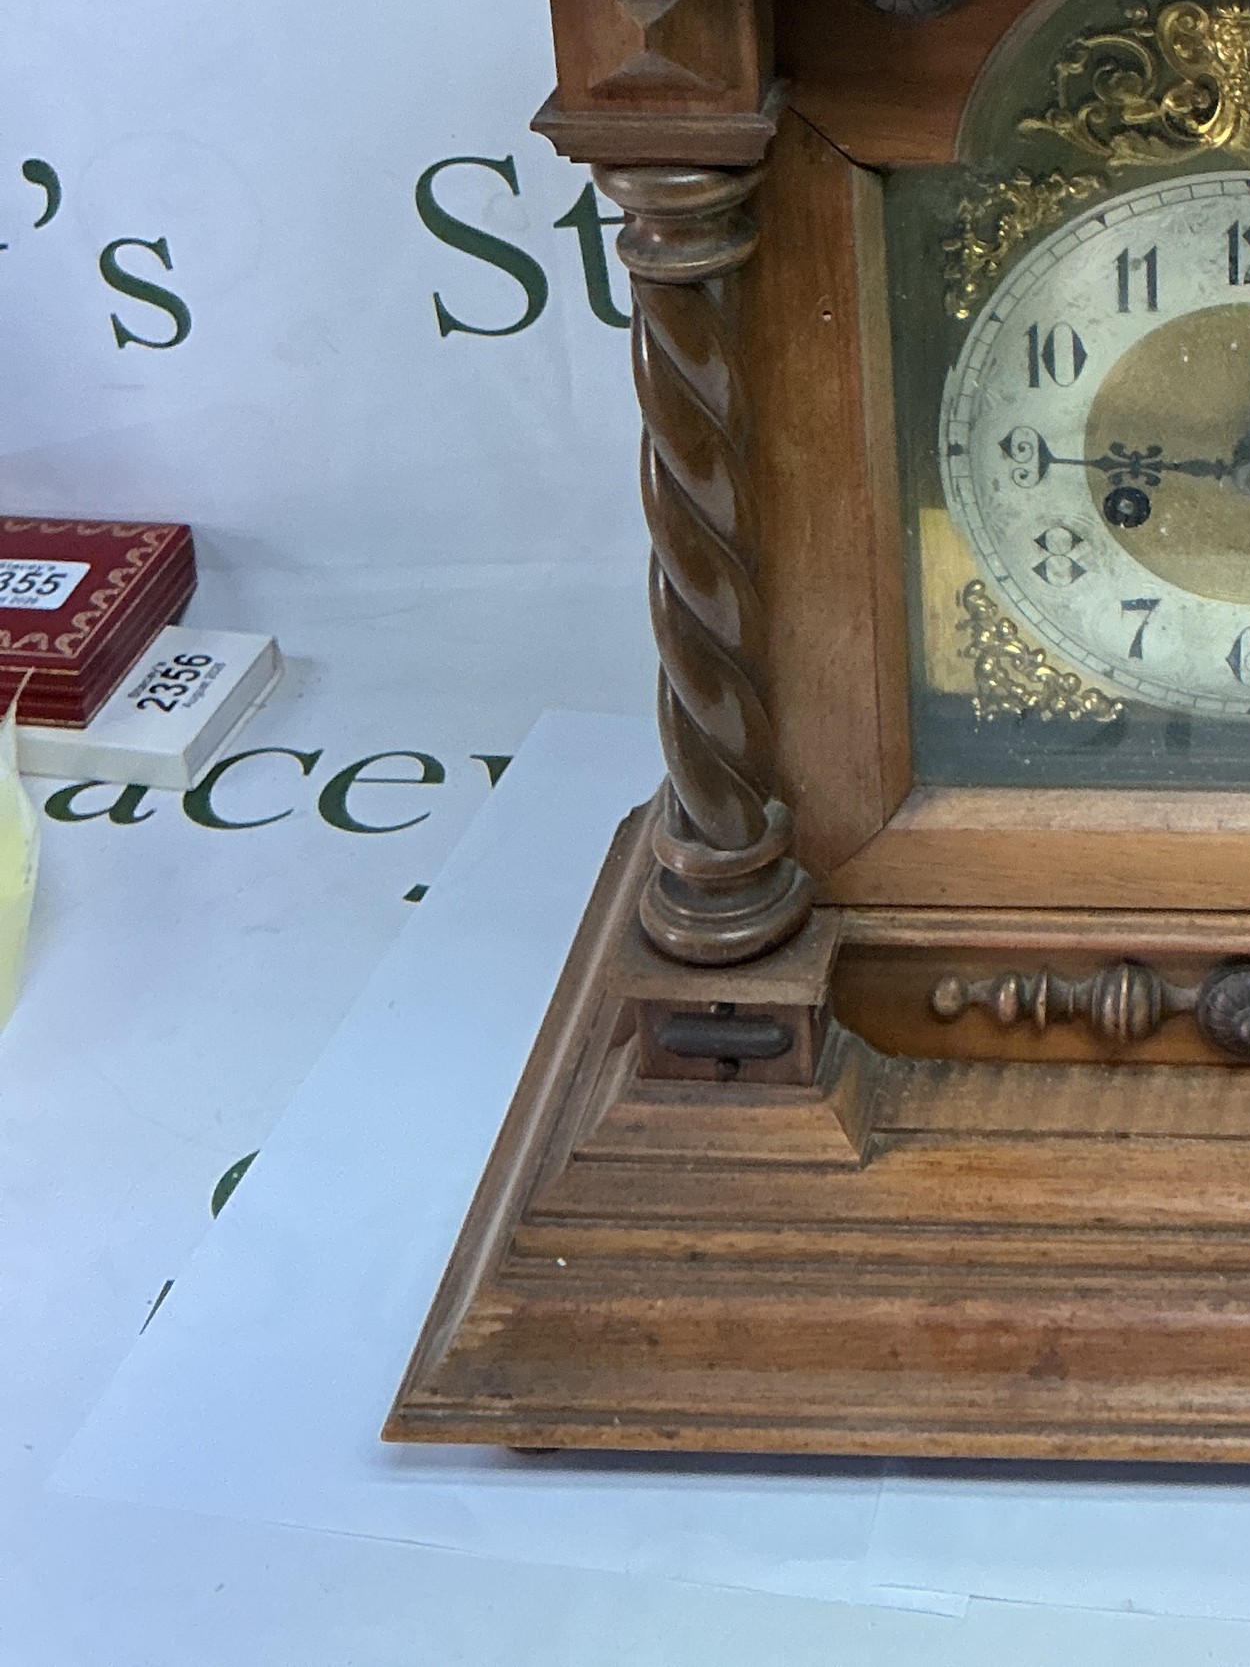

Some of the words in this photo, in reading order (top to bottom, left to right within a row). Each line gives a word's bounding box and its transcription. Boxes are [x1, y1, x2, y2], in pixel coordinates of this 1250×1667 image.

[0, 157, 192, 350] 's
[1115, 246, 1160, 313] 11
[1024, 322, 1089, 389] 10
[997, 426, 1052, 489] 9
[1032, 526, 1086, 589] 8
[1120, 598, 1161, 660] 7
[136, 654, 213, 712] 2356
[43, 747, 514, 902] ace
